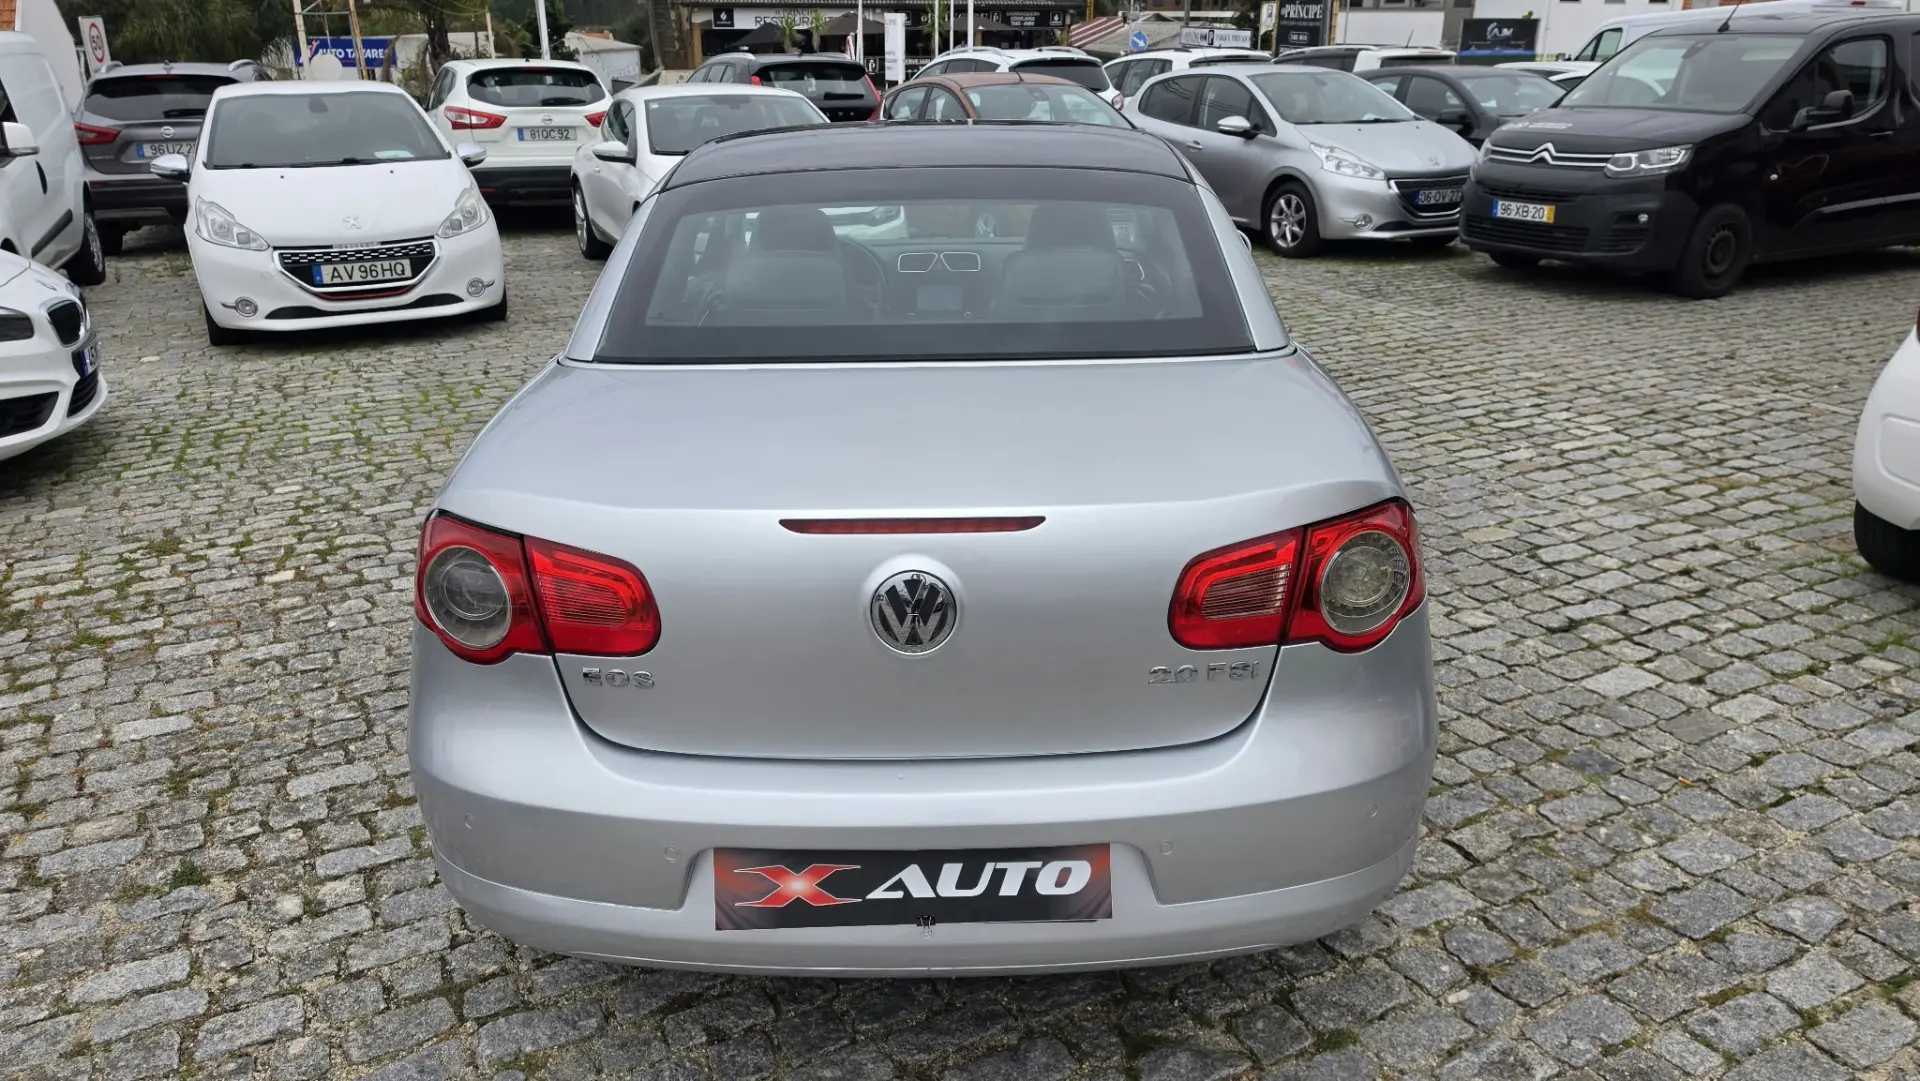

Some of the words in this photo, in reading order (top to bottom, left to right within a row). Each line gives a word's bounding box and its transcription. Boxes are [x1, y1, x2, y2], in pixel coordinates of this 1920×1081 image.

[91, 34, 102, 51] 50
[582, 666, 655, 689] EOS
[1206, 660, 1260, 682] FSI
[734, 863, 862, 908] X
[865, 860, 1092, 900] AUTO
